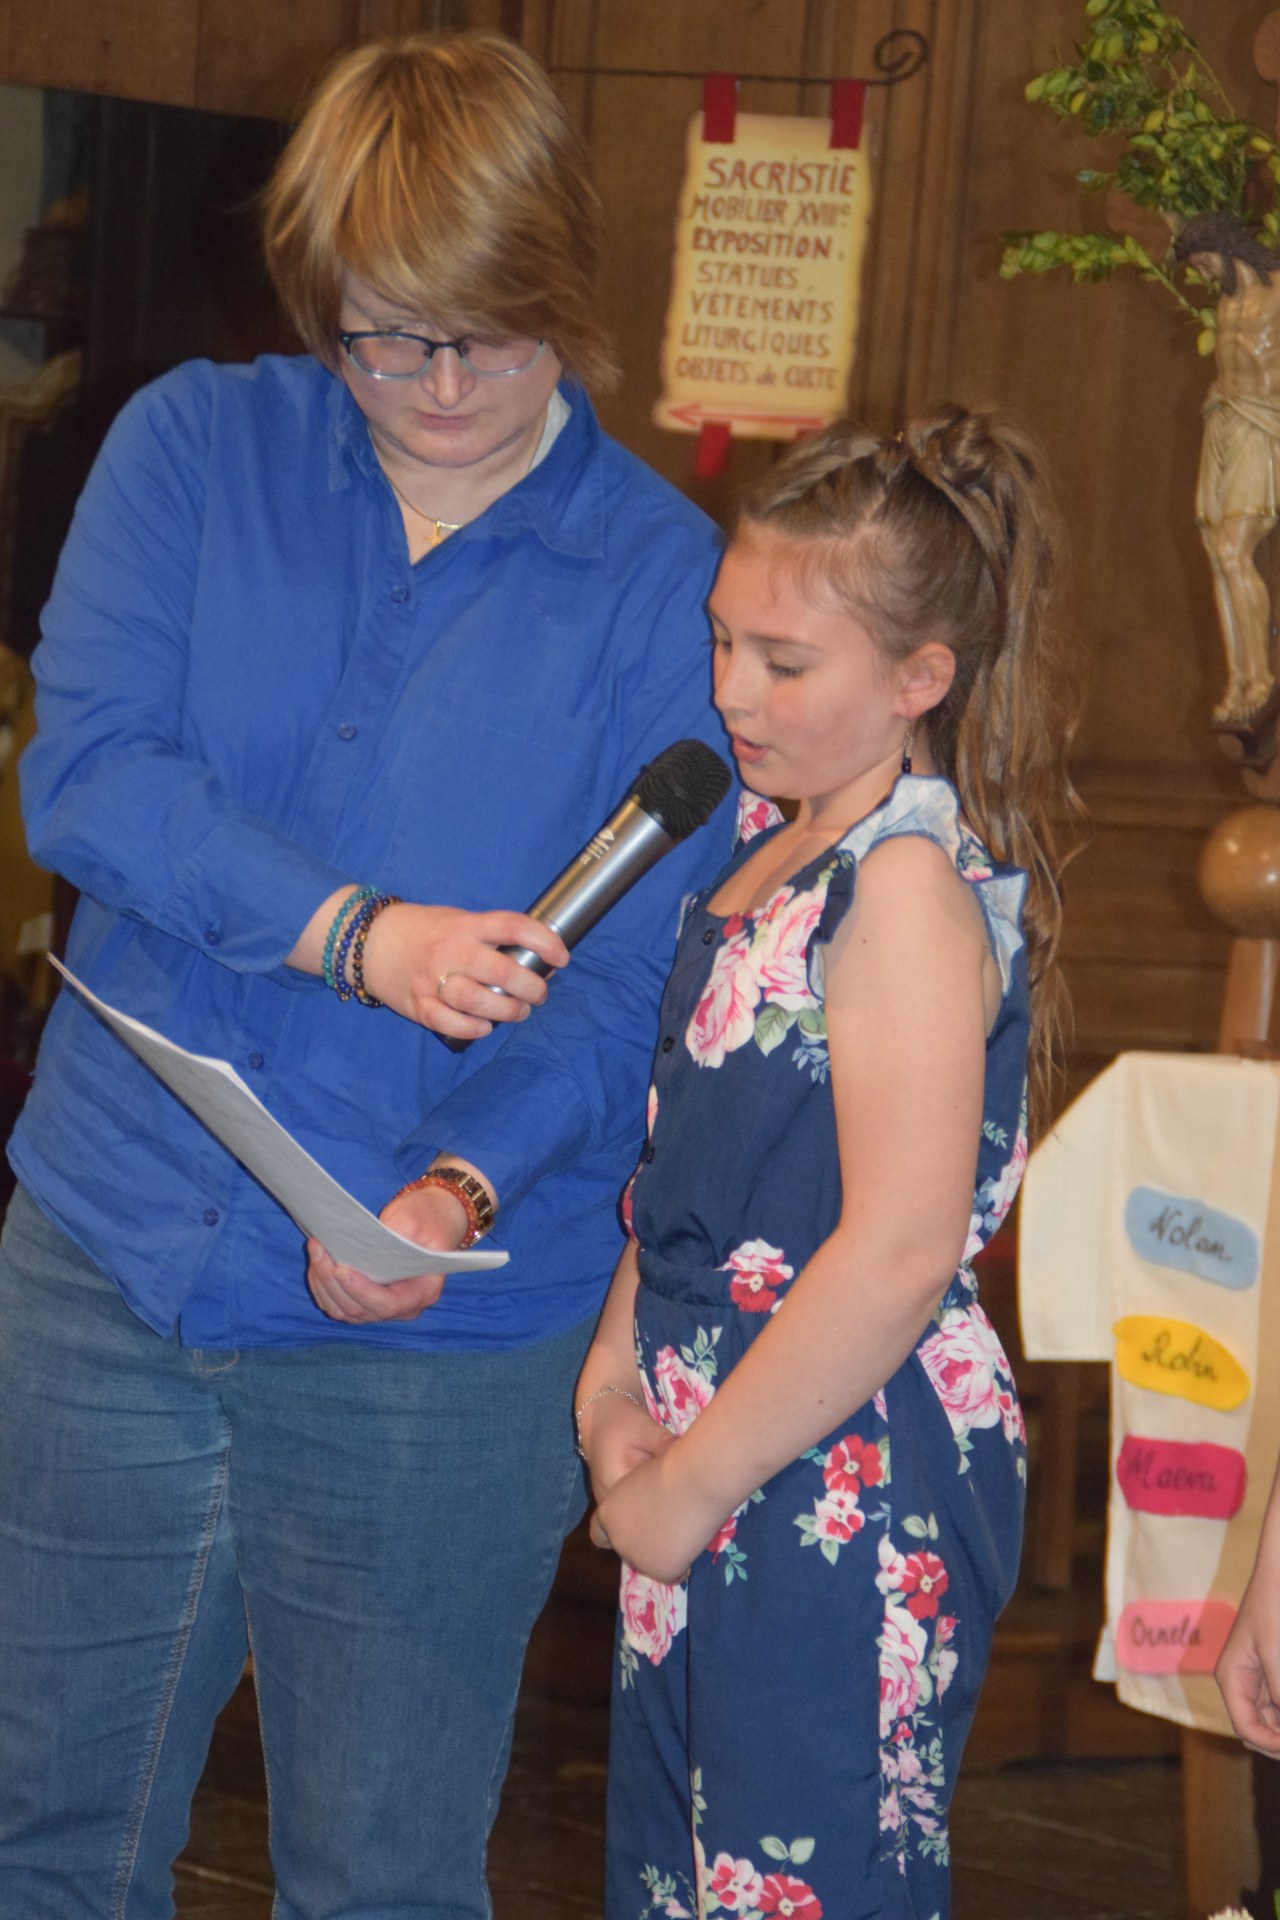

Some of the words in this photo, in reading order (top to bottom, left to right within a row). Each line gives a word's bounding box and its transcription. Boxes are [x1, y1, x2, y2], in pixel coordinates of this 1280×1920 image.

[704, 156, 855, 195] SACRISTIE
[688, 193, 788, 226] MOBILIER
[681, 320, 831, 359] LITURGIQUES
[675, 356, 752, 385] OBJETS
[1150, 1205, 1233, 1263] Nolan
